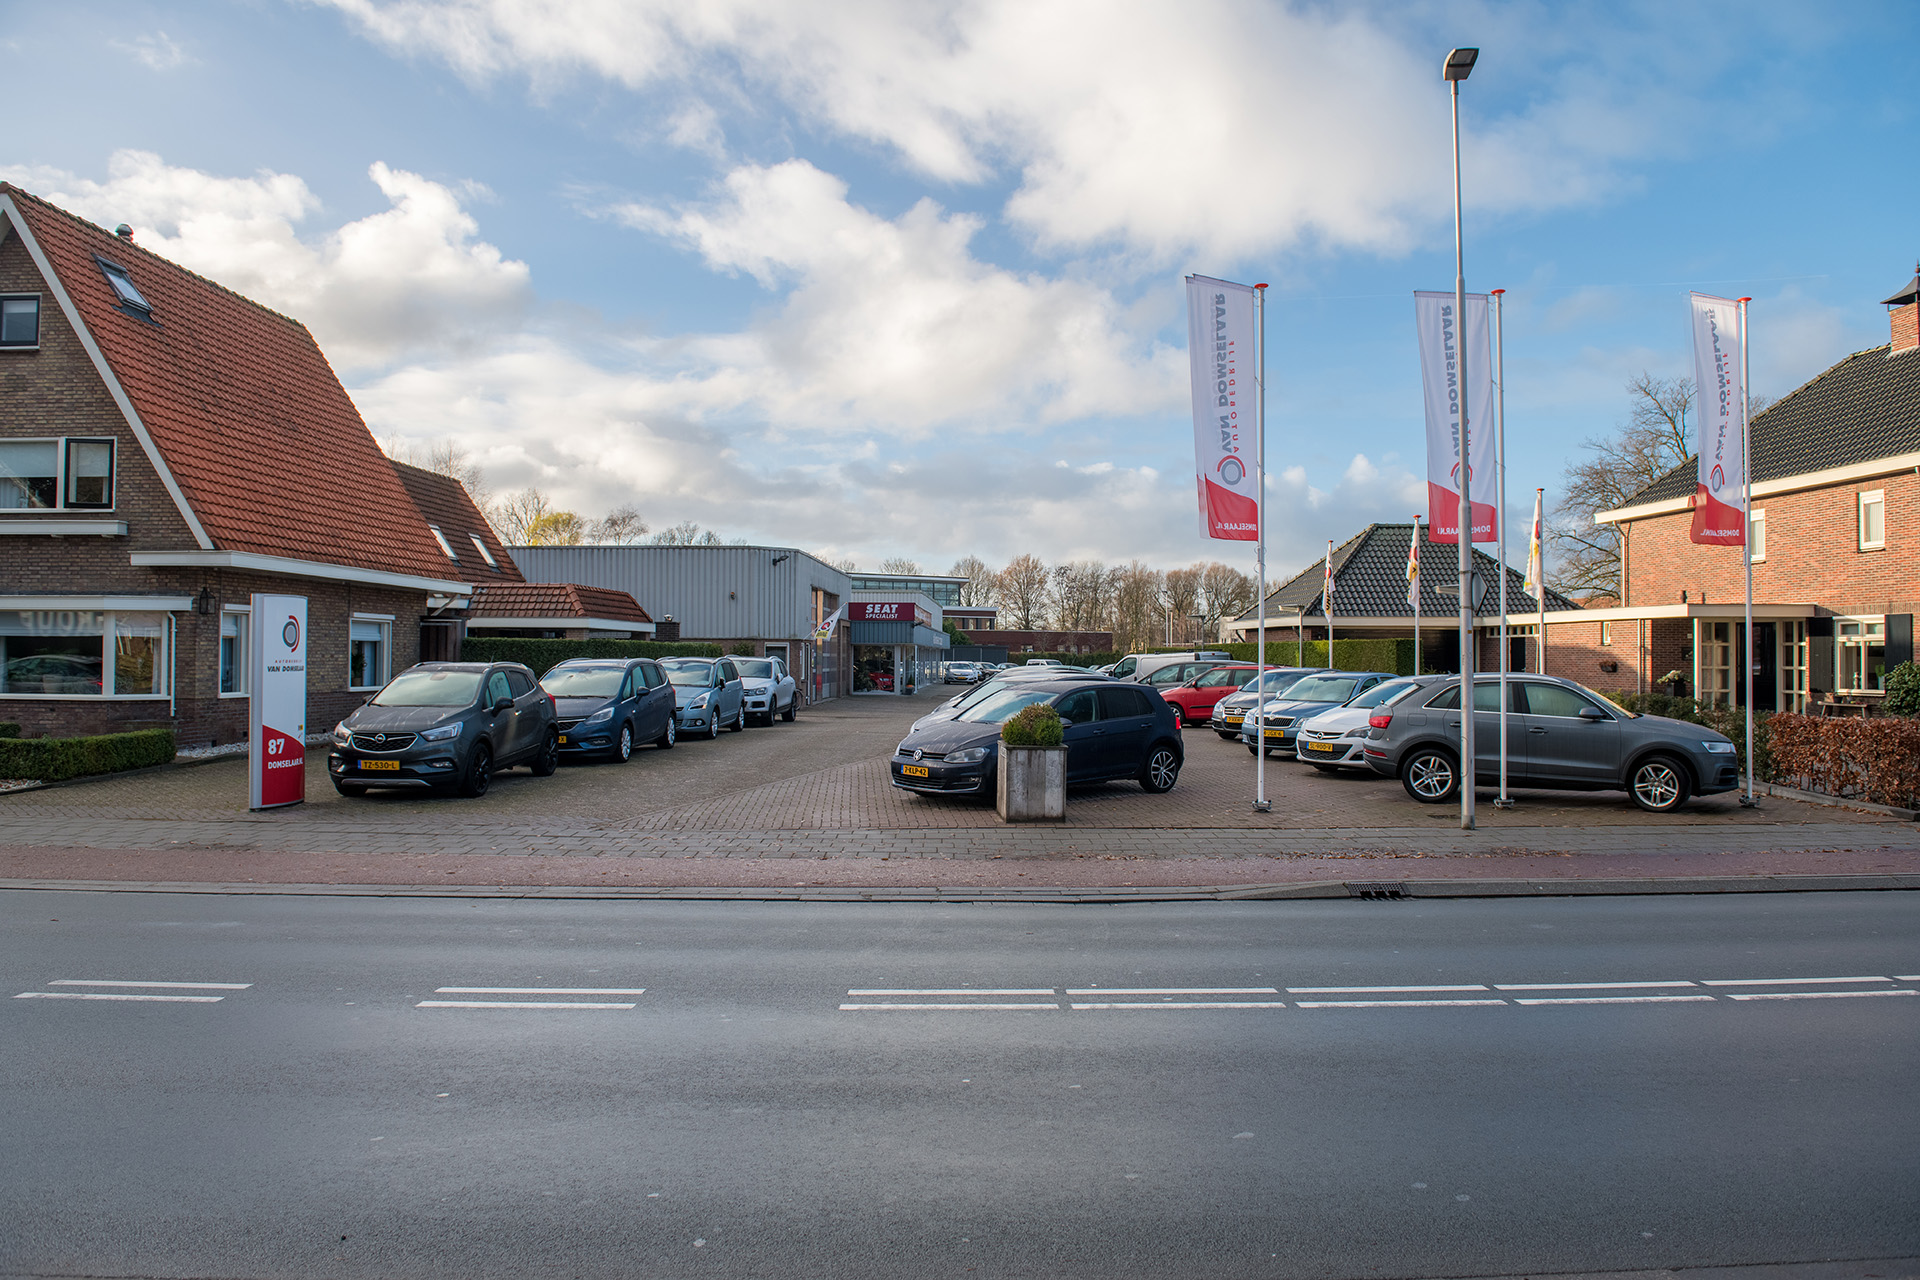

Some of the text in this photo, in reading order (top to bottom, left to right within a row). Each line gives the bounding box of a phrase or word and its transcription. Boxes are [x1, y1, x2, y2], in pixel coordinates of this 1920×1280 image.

[865, 604, 899, 613] SEAT
[268, 738, 285, 755] 87
[364, 761, 397, 769] TZ-530-L
